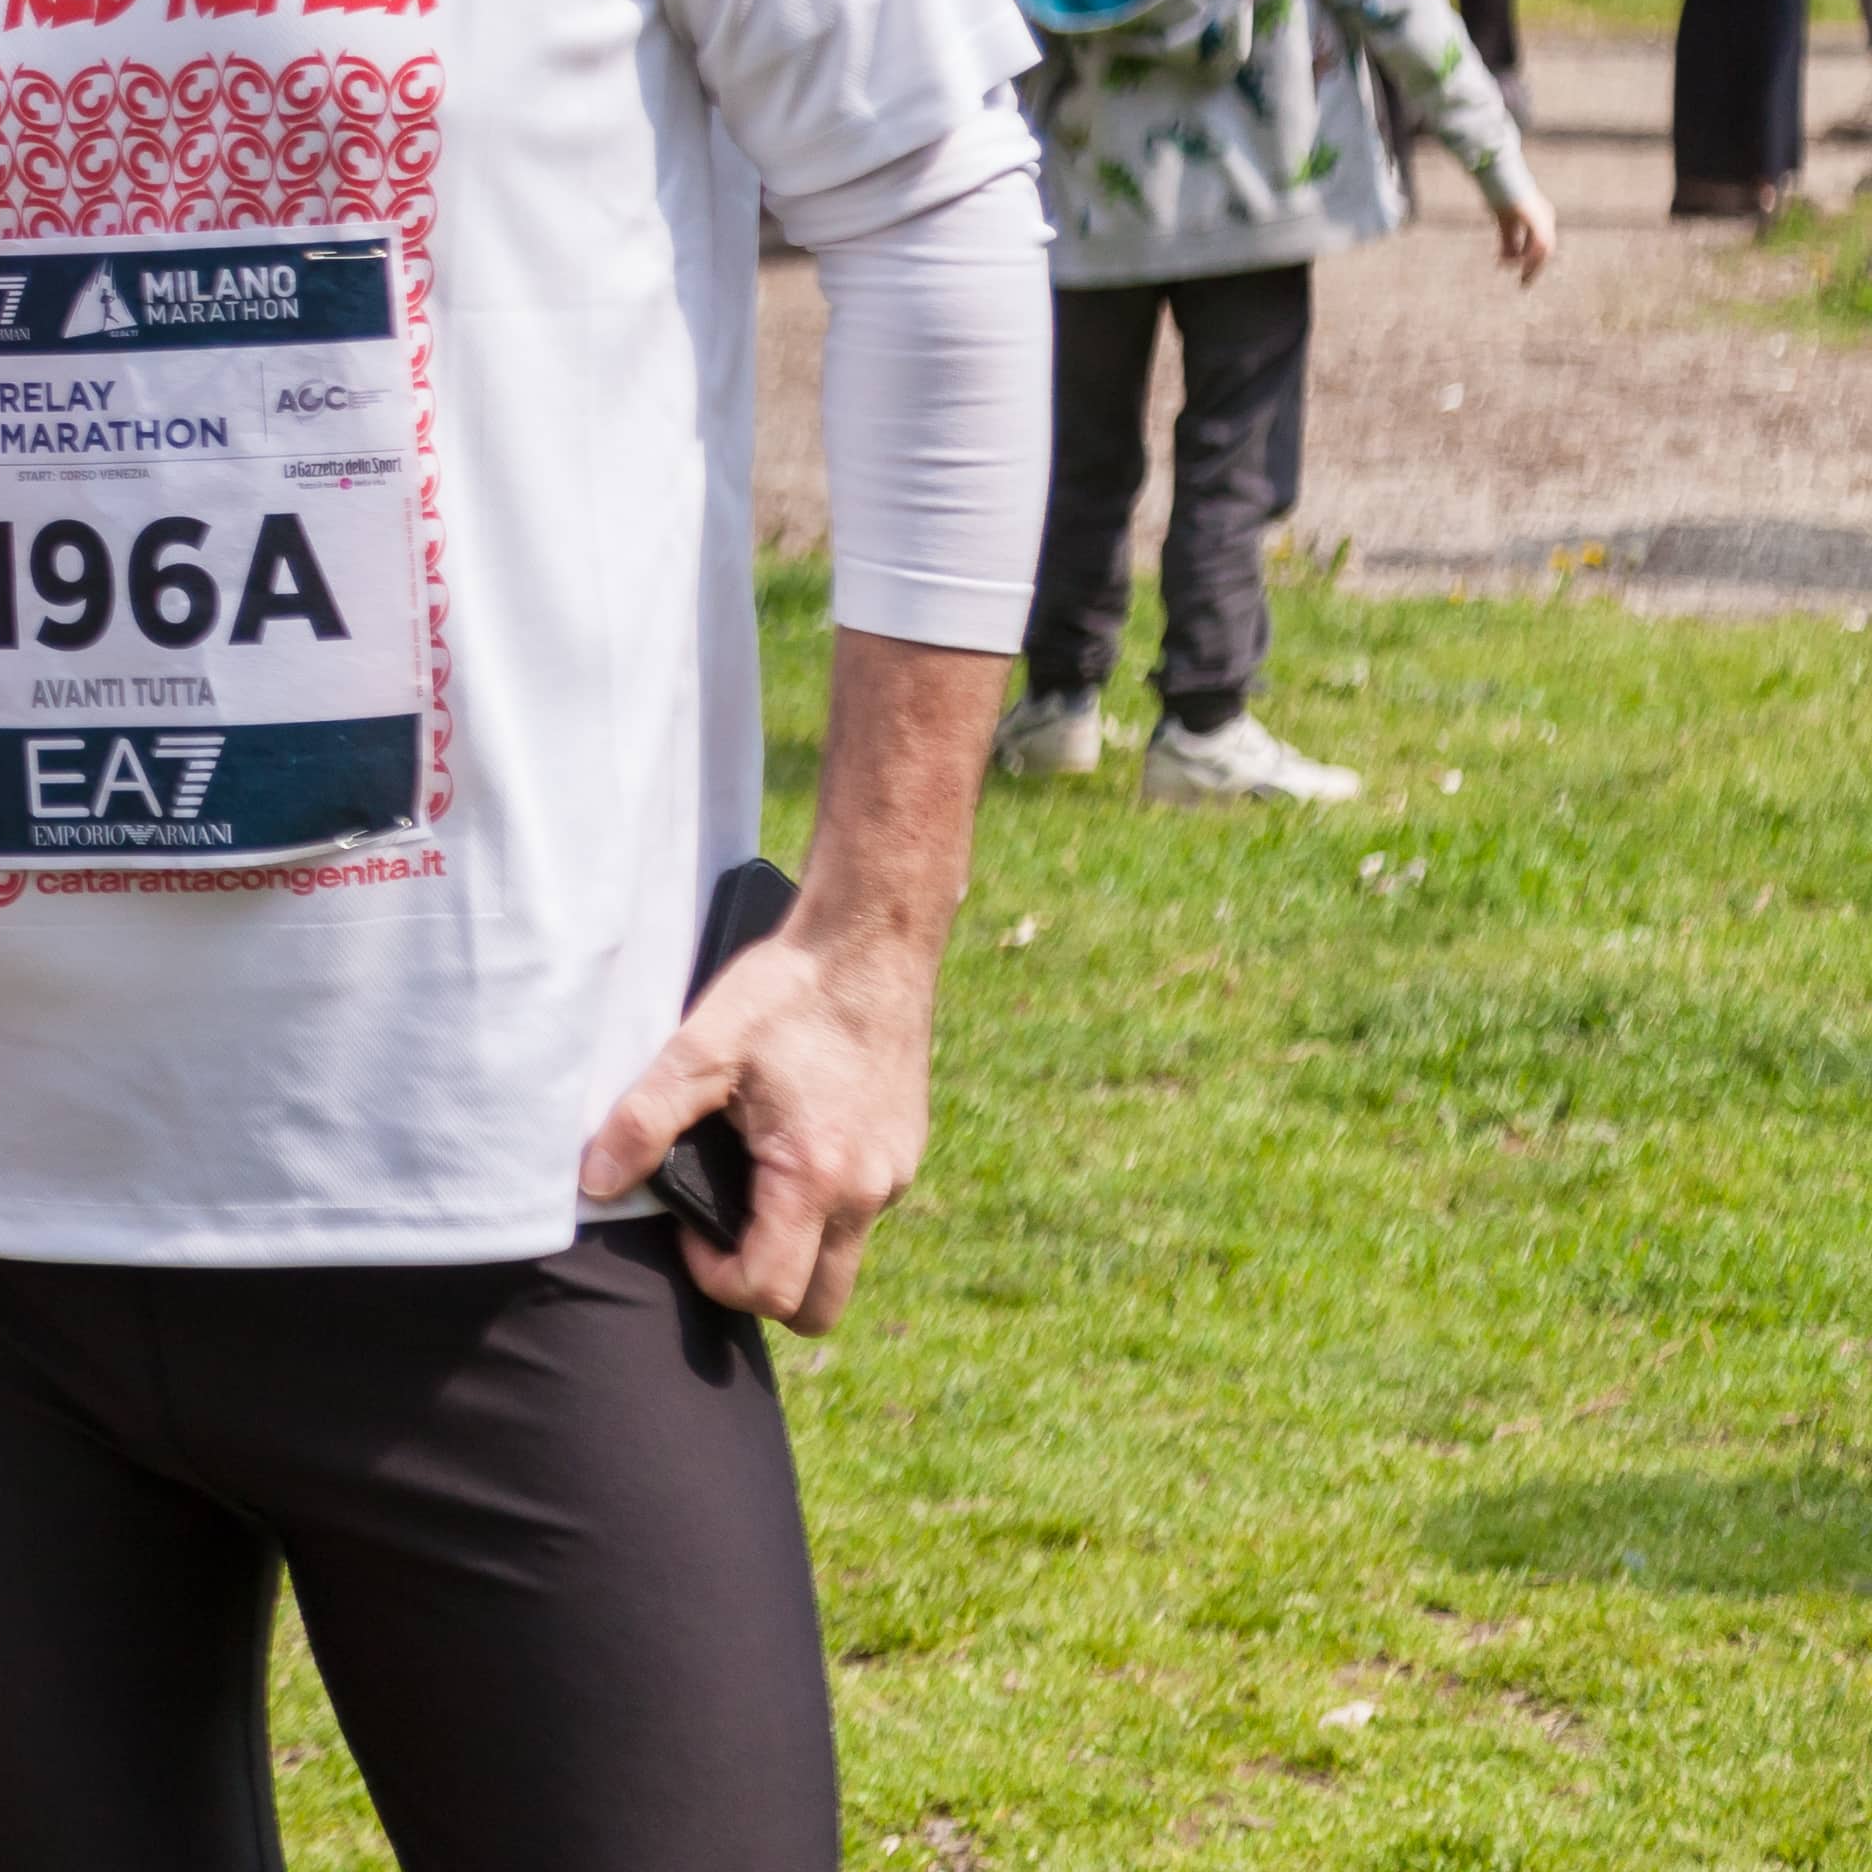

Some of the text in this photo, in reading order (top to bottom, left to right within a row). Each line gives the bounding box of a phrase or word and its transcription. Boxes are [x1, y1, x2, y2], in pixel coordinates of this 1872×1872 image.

[142, 265, 298, 303] MILANO
[146, 298, 300, 325] MARATHON
[0, 417, 229, 455] MARATHON
[18, 470, 56, 482] START:
[100, 468, 151, 481] VENEZIA
[298, 460, 344, 478] Gazzetta
[31, 677, 215, 709] AVANTI TUTTA
[27, 734, 226, 819] EA7
[32, 822, 233, 847] EMPORIO ARMANI
[37, 849, 447, 896] catarattacongenita.it
